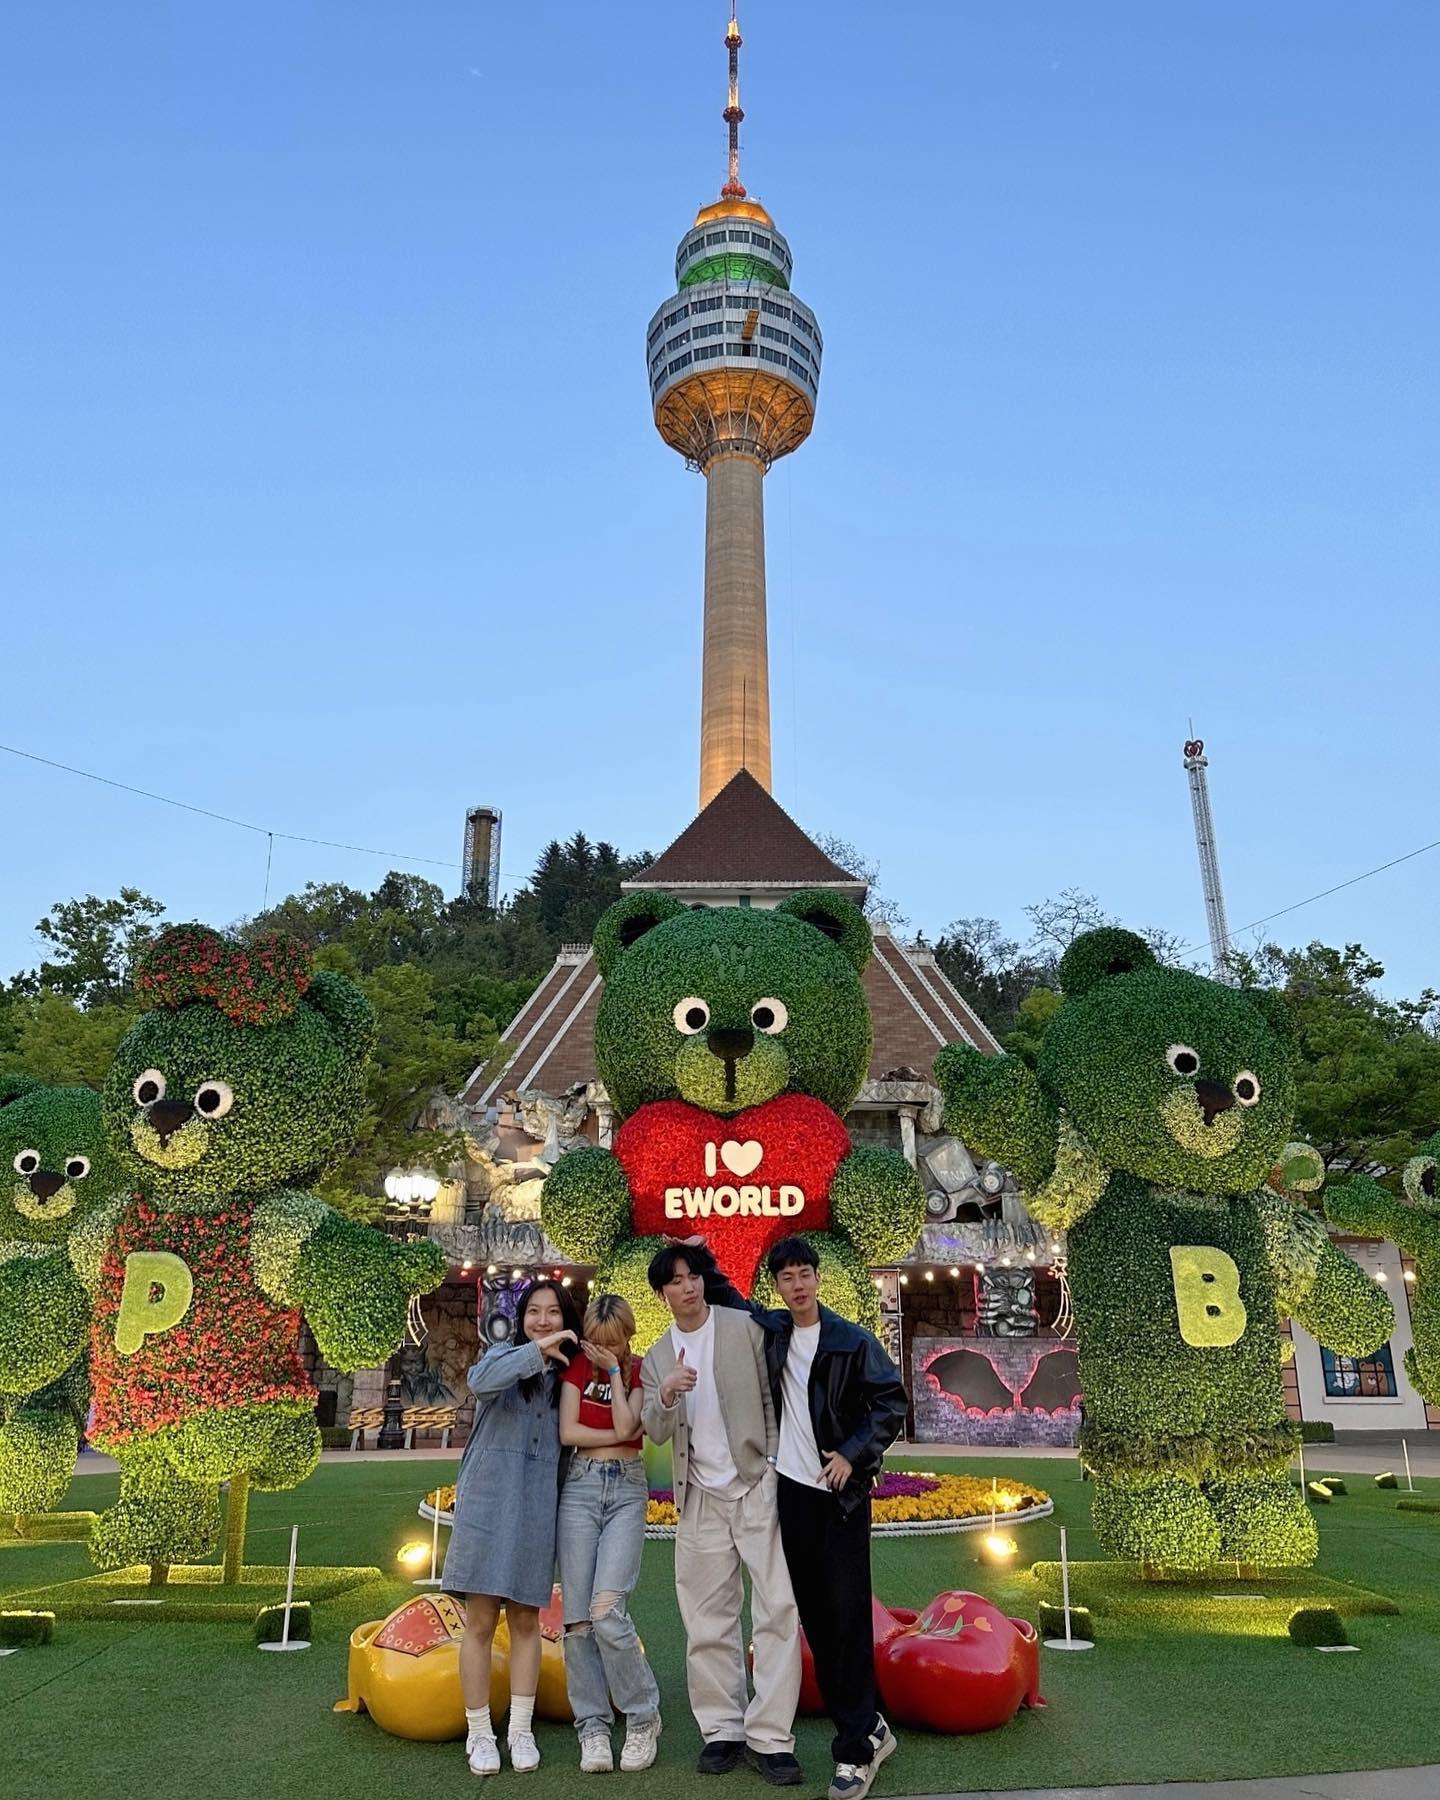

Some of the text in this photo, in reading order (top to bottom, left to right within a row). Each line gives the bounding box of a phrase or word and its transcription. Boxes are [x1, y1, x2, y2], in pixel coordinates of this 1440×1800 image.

[704, 1141, 717, 1177] I
[665, 1185, 805, 1219] EWORLD
[114, 1251, 193, 1355] P
[1169, 1245, 1247, 1347] B
